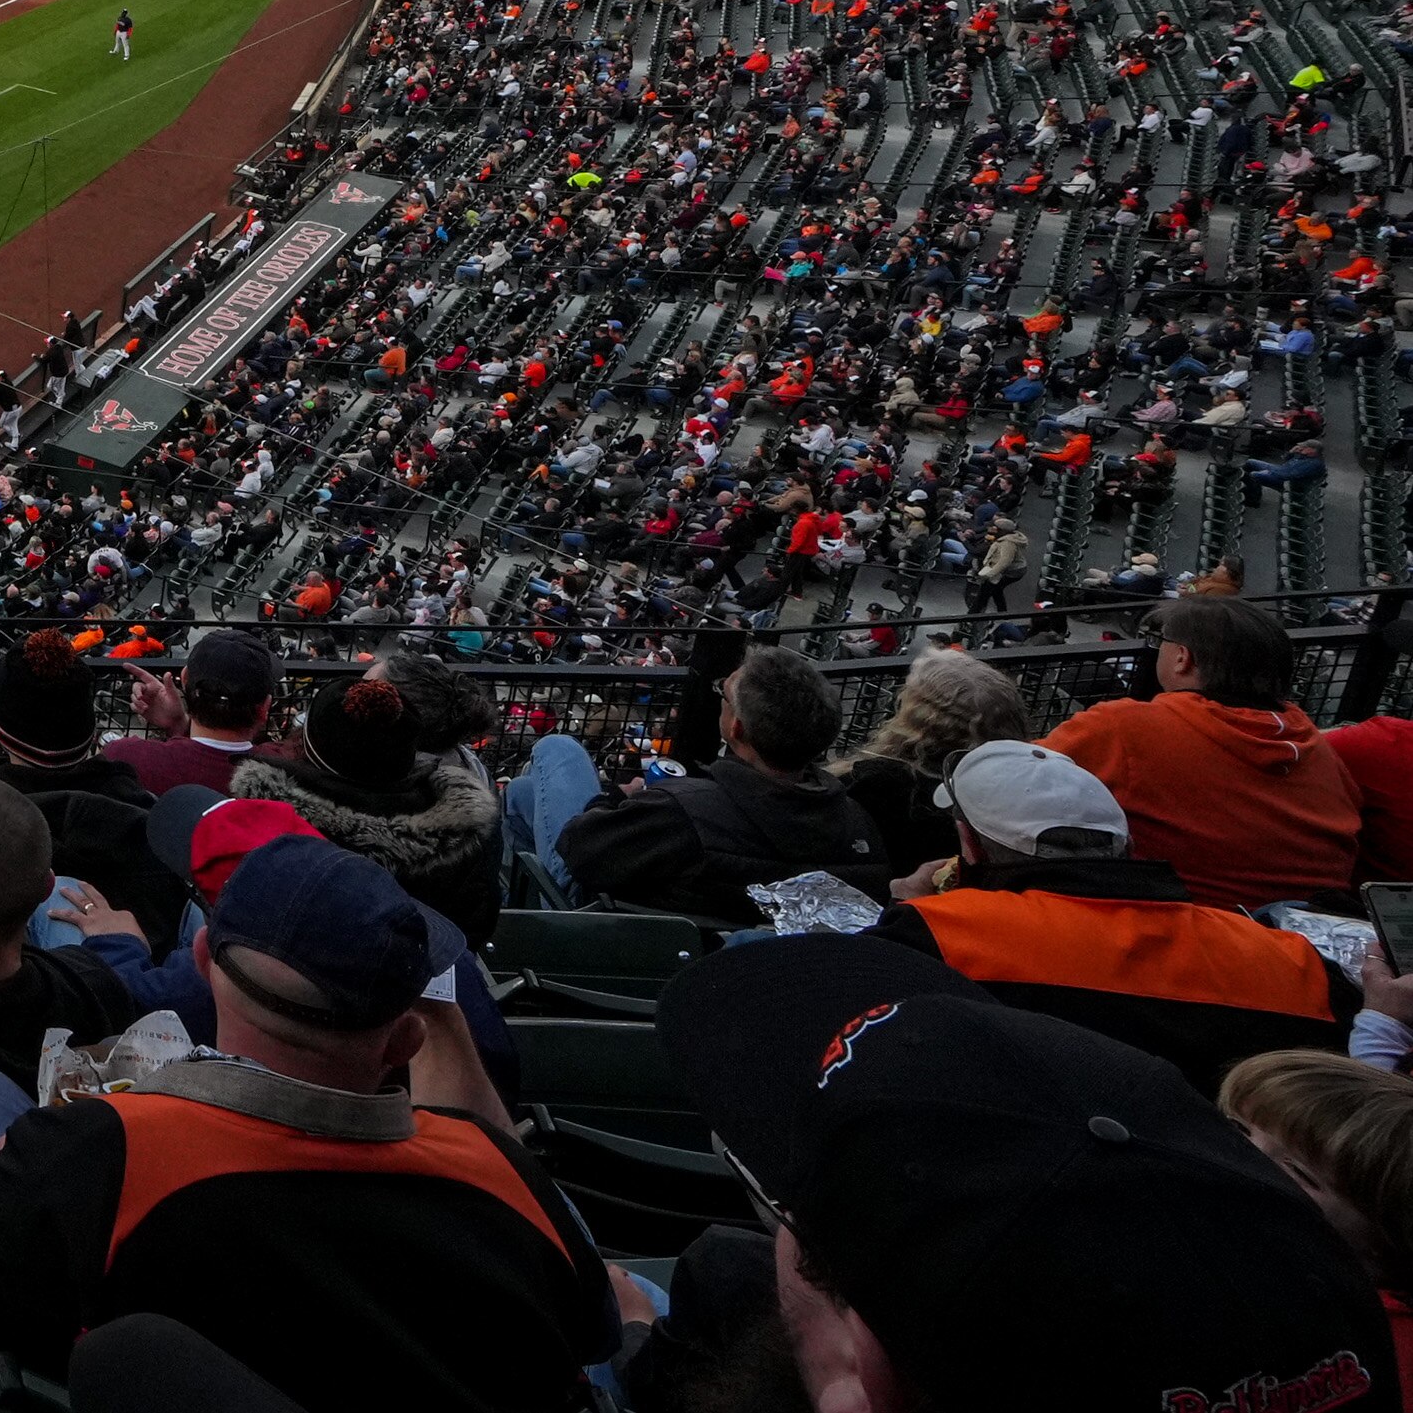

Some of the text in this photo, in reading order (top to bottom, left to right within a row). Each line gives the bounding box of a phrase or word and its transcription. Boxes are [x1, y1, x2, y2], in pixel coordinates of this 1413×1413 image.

[155, 227, 332, 378] HOME OF THE ORIOLES
